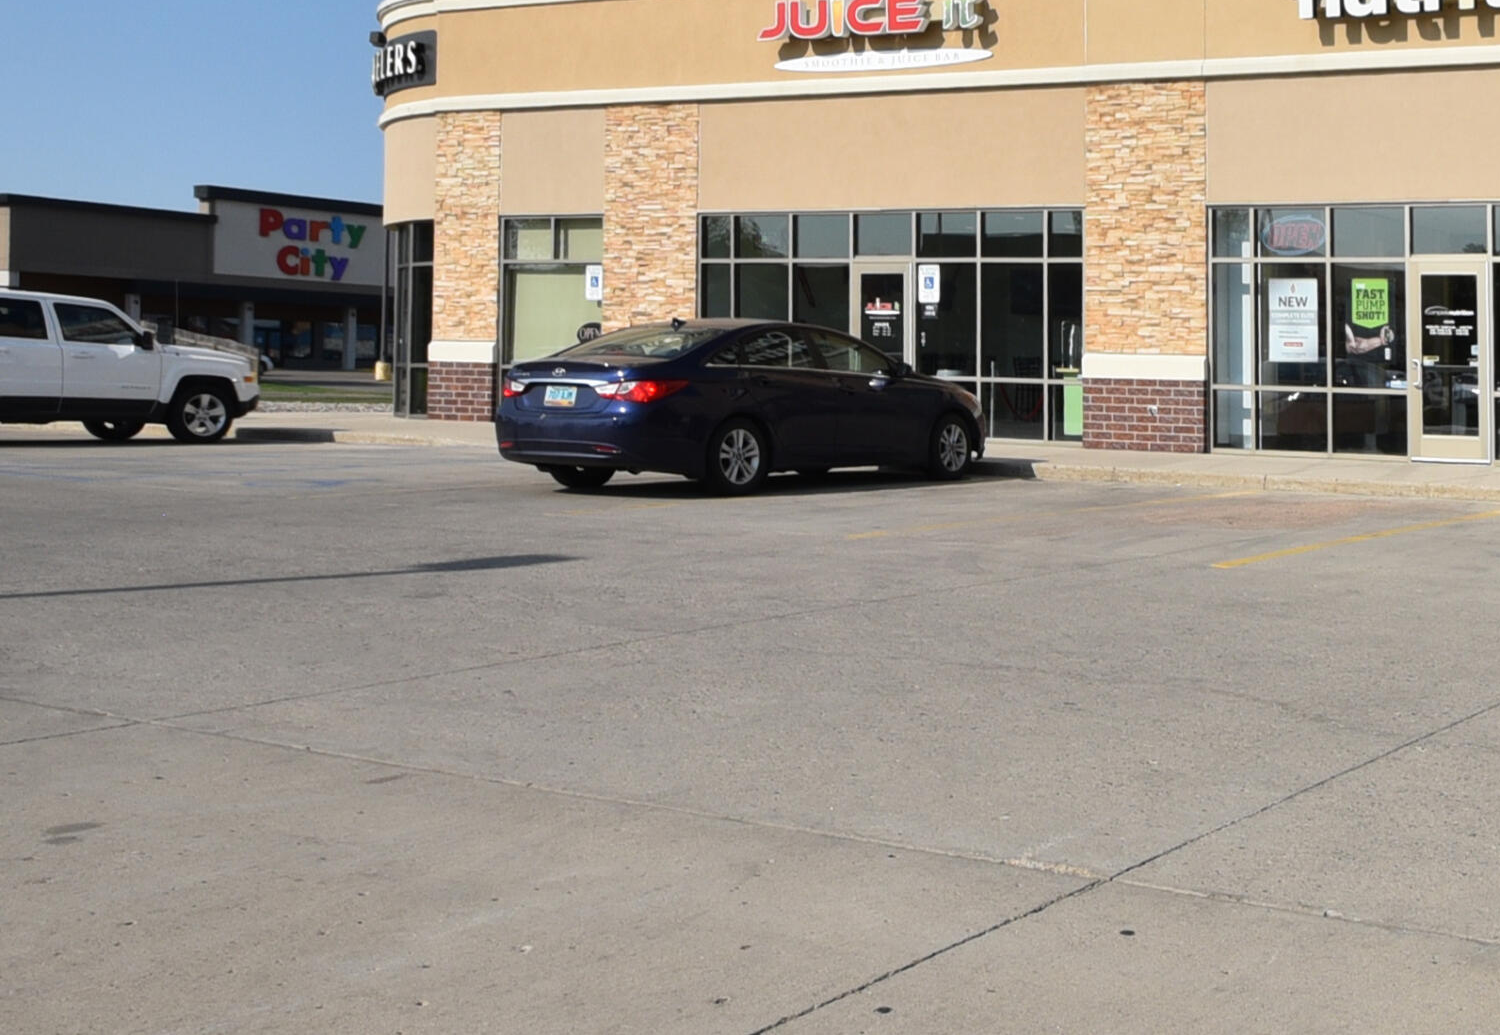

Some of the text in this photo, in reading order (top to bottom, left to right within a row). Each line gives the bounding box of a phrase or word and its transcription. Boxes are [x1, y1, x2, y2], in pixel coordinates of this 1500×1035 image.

[371, 40, 417, 84] ELERS
[891, 53, 929, 66] JUICE
[935, 52, 961, 63] BAR
[259, 208, 367, 249] Party
[276, 245, 349, 281] City
[1356, 289, 1385, 299] FAST
[1278, 296, 1308, 308] NEW
[1356, 300, 1386, 310] PUMP
[1356, 311, 1386, 320] SHOT!
